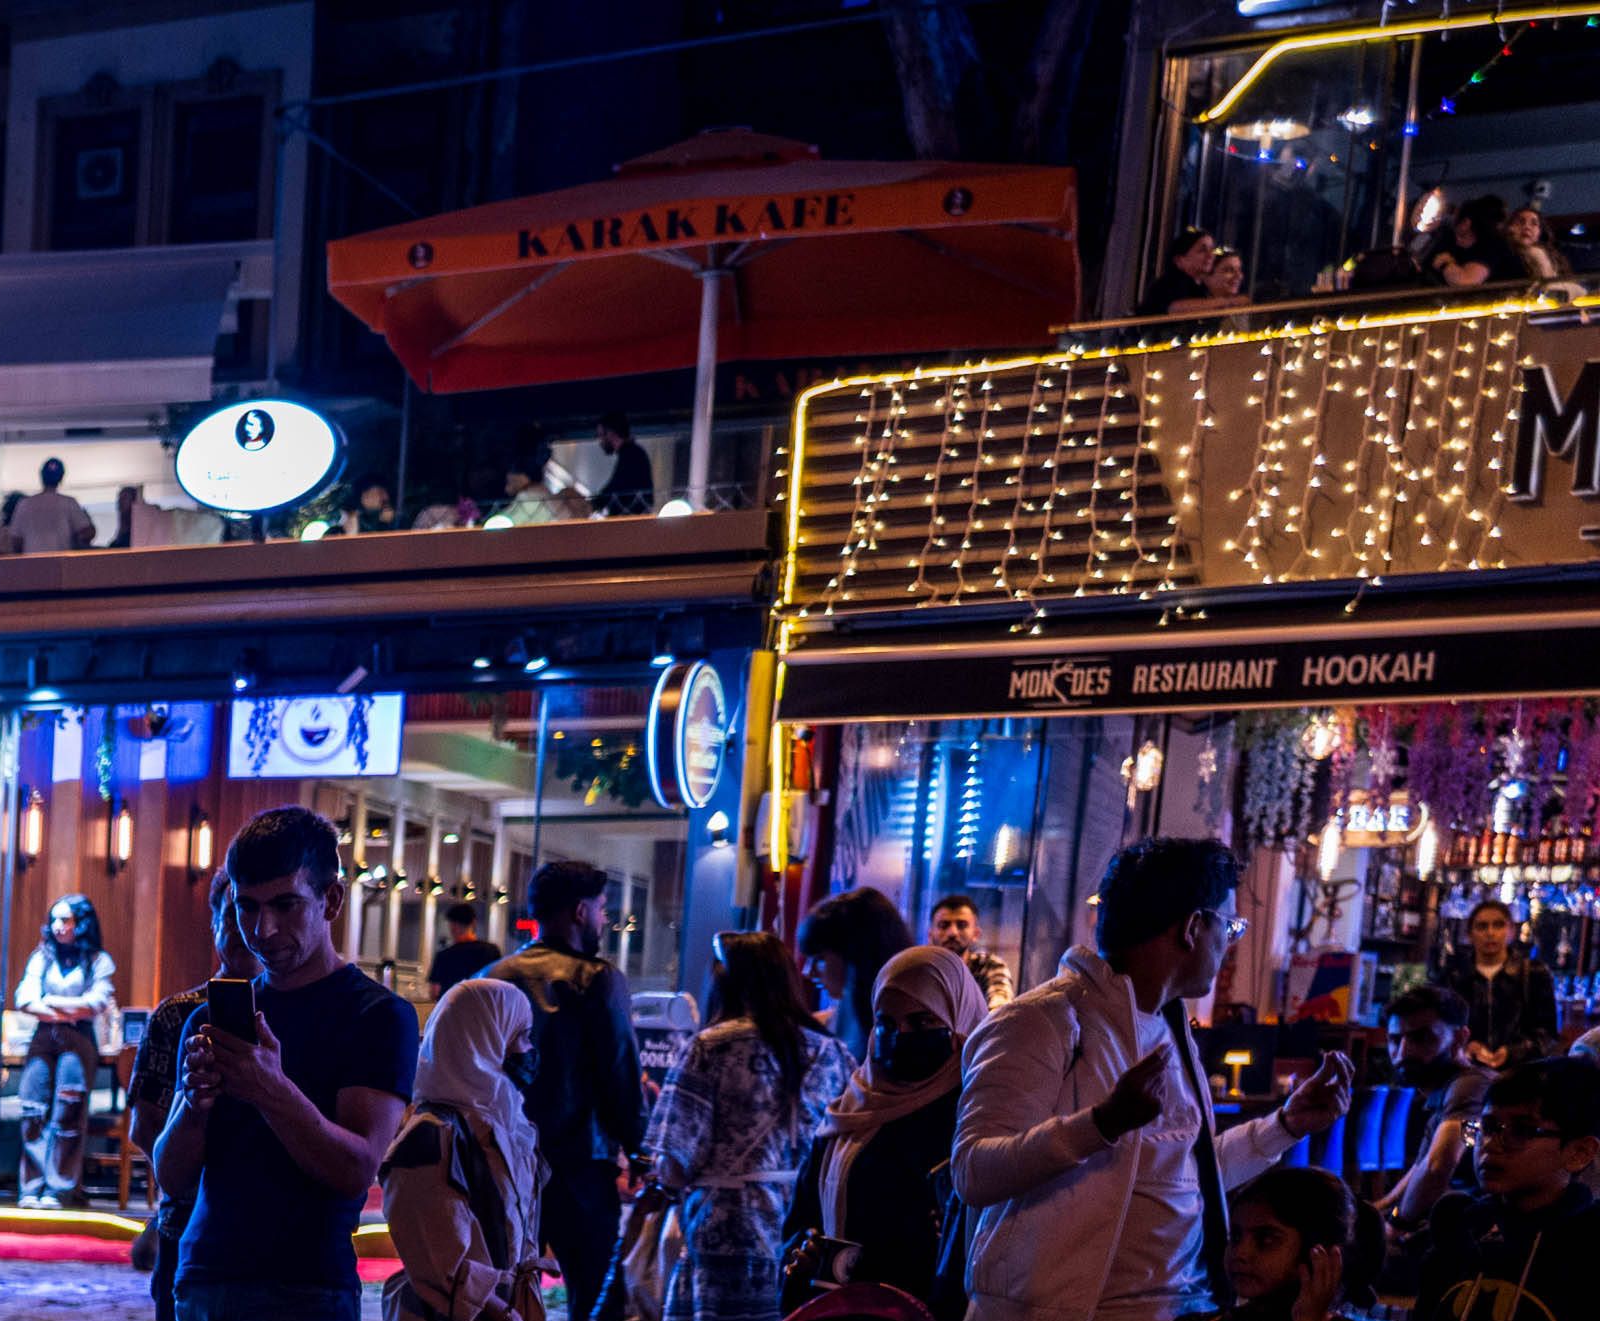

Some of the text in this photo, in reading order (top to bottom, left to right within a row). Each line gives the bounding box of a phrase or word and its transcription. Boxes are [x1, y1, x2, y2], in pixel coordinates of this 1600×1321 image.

[518, 193, 855, 258] KARAK KAFE
[1131, 659, 1278, 694] RESTAURANT
[1301, 651, 1437, 687] HOOKAH
